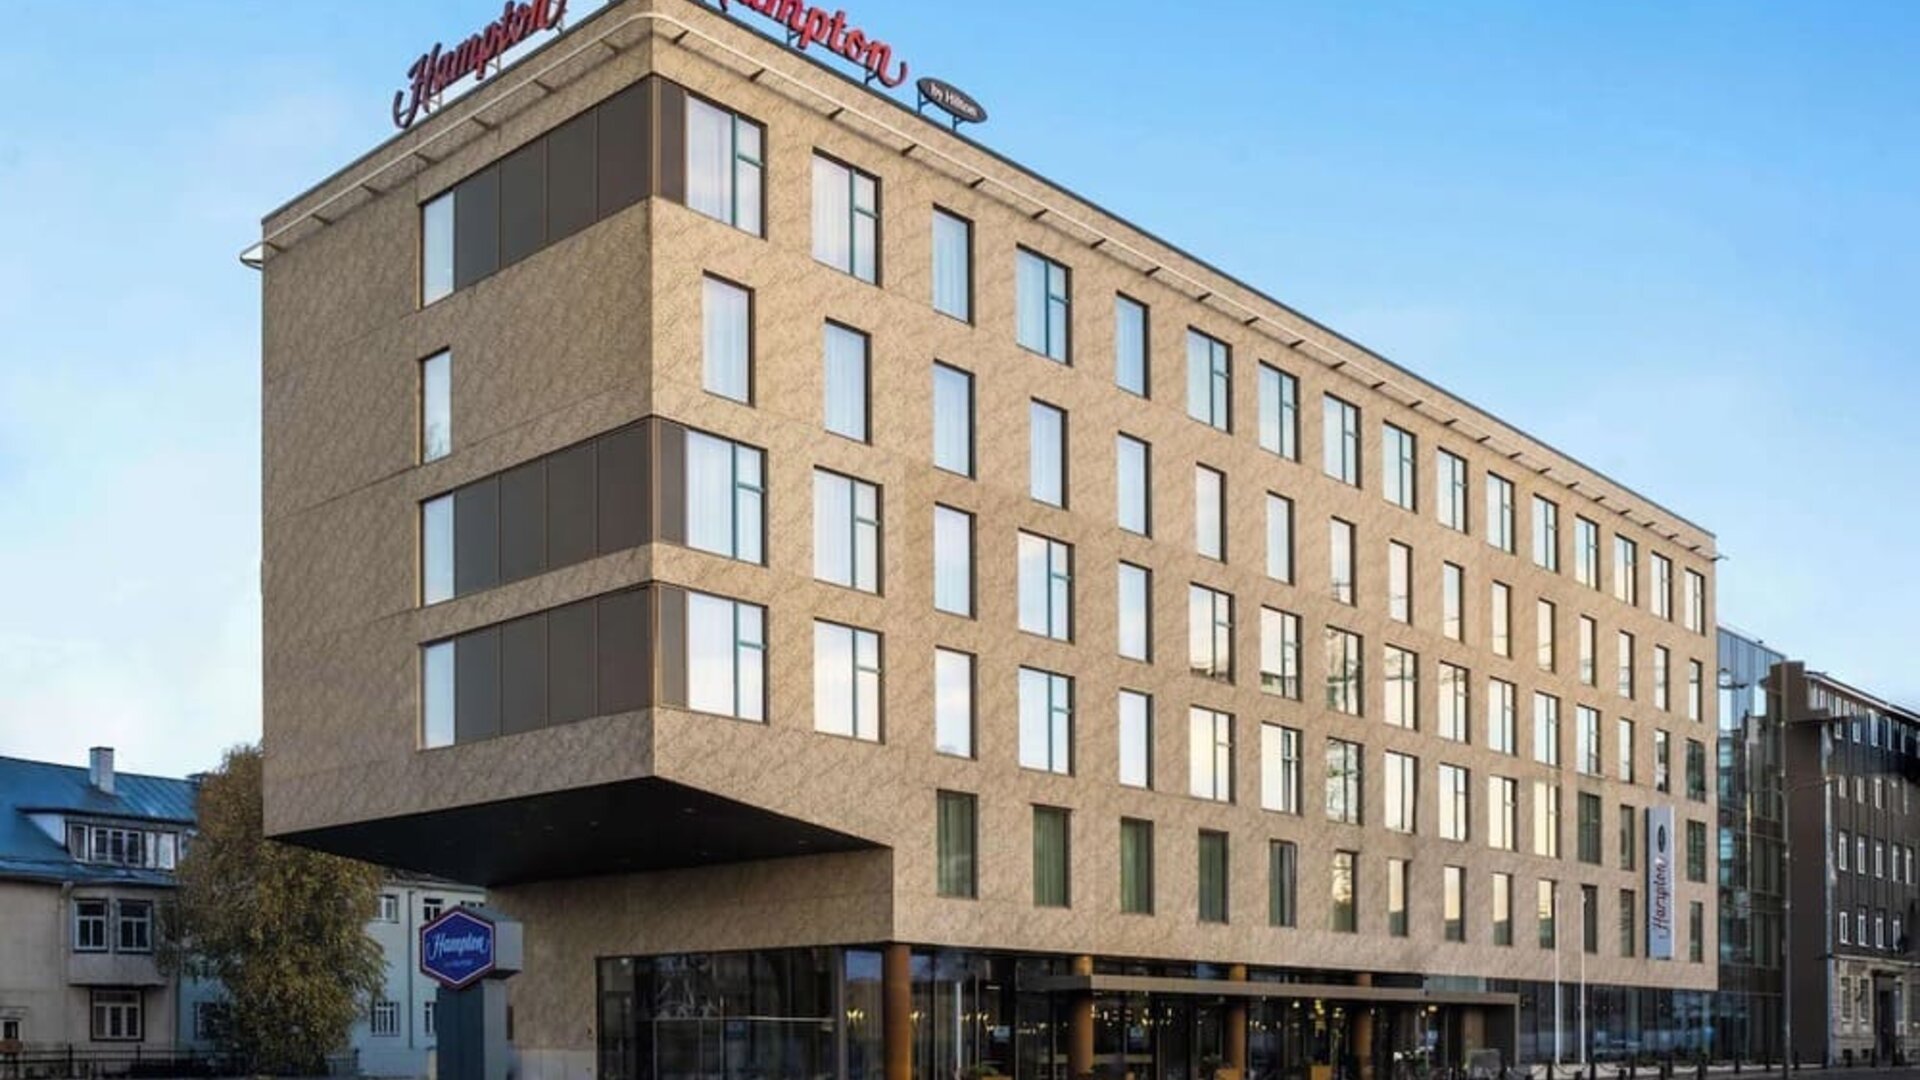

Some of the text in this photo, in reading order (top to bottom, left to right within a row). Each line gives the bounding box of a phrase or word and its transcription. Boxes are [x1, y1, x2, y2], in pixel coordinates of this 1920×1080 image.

[393, 0, 566, 129] Hampton
[945, 89, 978, 119] Hilton
[1652, 854, 1671, 939] Hampton
[426, 931, 489, 961] Hampton
